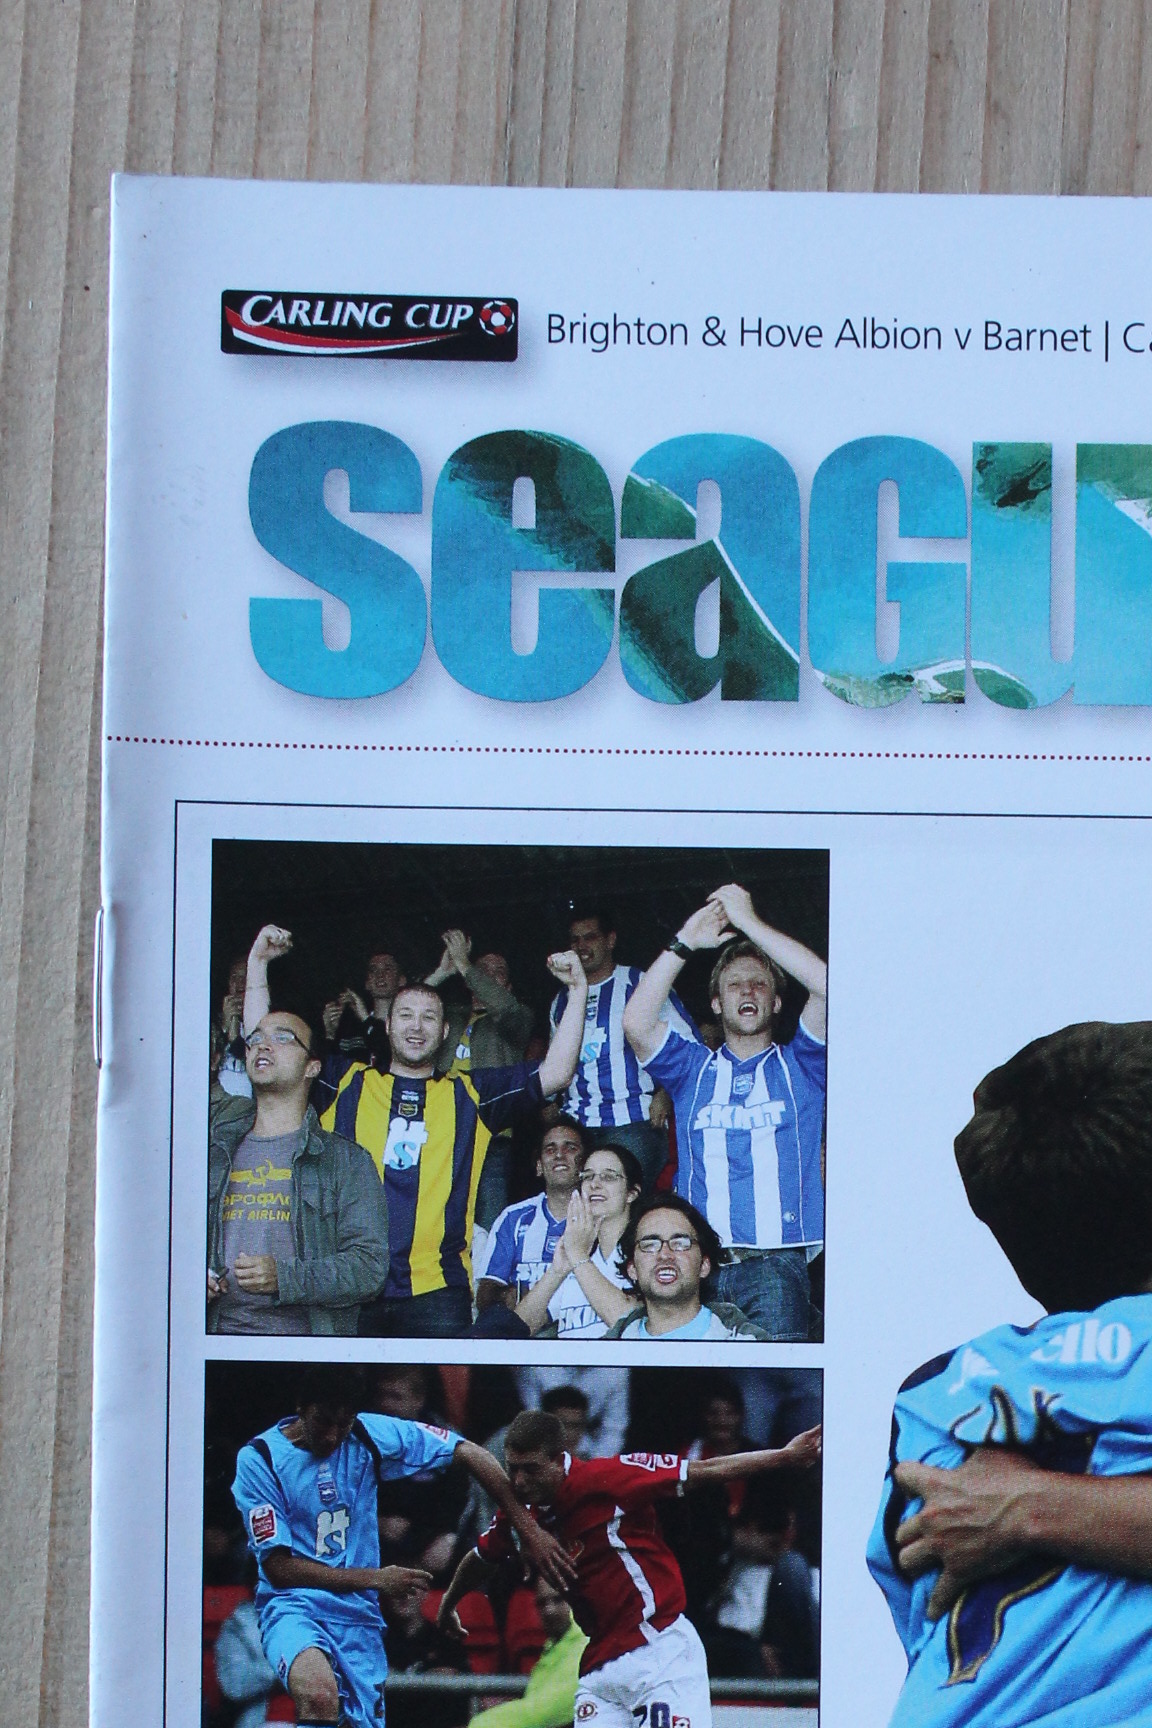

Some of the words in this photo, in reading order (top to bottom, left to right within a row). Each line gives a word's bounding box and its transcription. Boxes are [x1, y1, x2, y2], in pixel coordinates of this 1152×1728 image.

[241, 294, 393, 328] CARLING
[405, 303, 474, 329] CUP
[547, 311, 688, 353] Brighton
[701, 316, 727, 347] &
[740, 316, 823, 348] Hove
[834, 316, 942, 350] Albion
[954, 328, 972, 350] v
[984, 320, 1092, 353] Barnet
